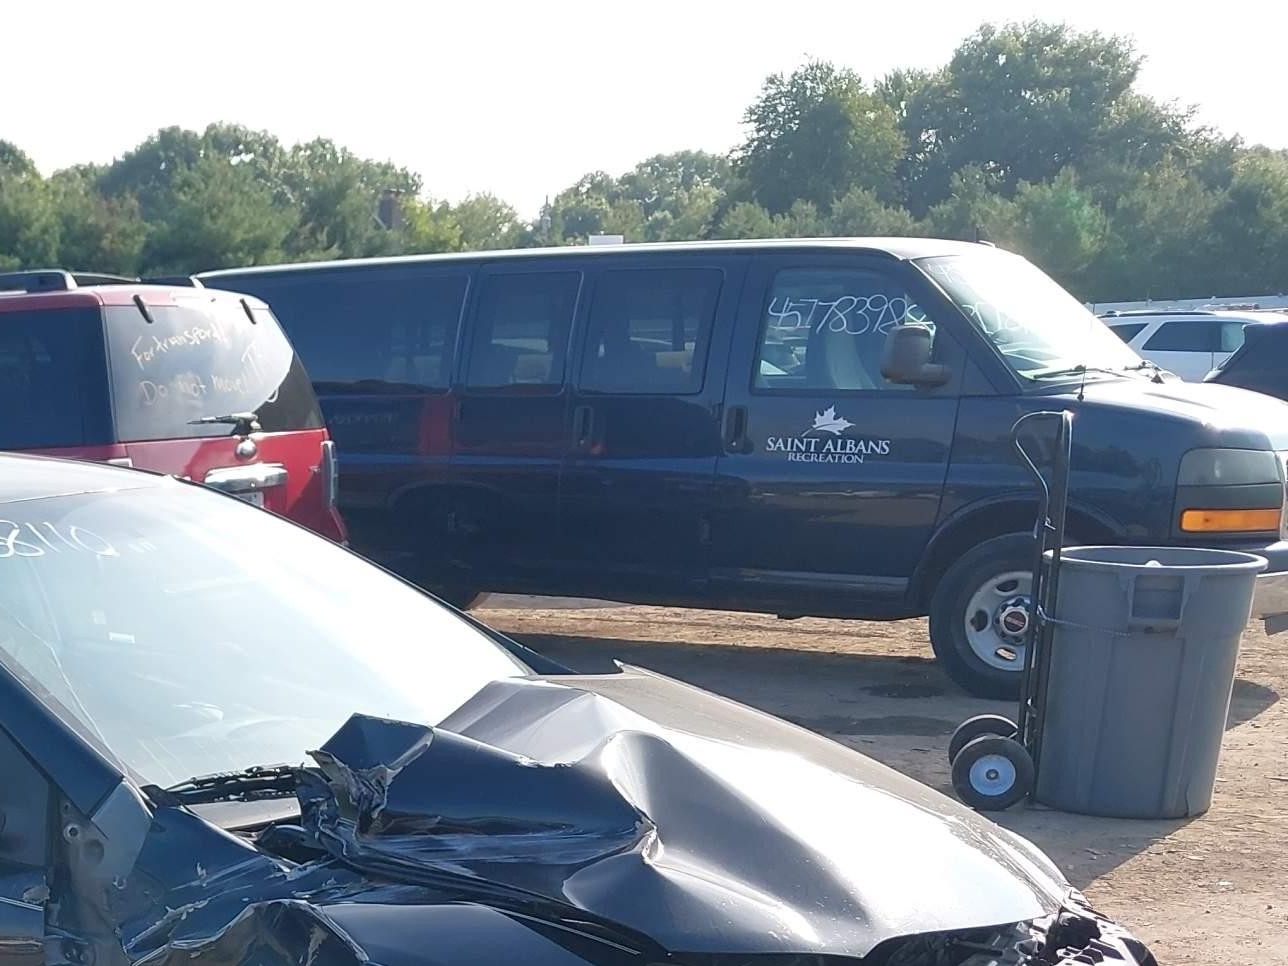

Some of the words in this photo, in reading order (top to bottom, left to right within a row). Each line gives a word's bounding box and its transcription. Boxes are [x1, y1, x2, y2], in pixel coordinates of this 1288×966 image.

[766, 436, 820, 452] SAINT
[822, 439, 890, 455] ALBANS
[787, 452, 864, 464] RECREATION
